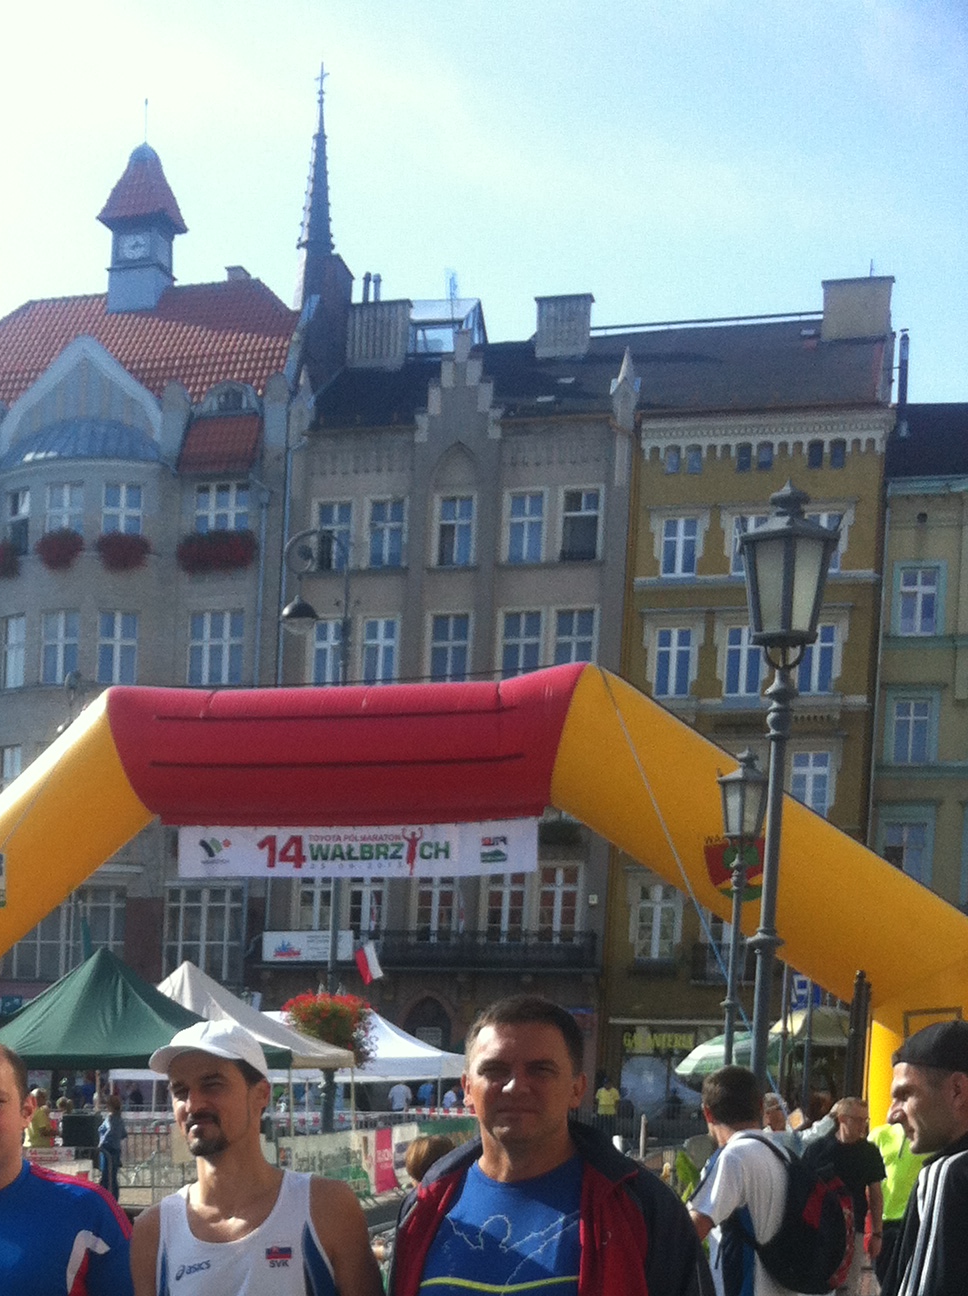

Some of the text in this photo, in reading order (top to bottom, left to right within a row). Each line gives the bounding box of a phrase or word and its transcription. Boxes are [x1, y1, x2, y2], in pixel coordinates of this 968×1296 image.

[257, 834, 306, 868] 14
[186, 1260, 211, 1275] asics
[269, 1259, 289, 1268] SVK
